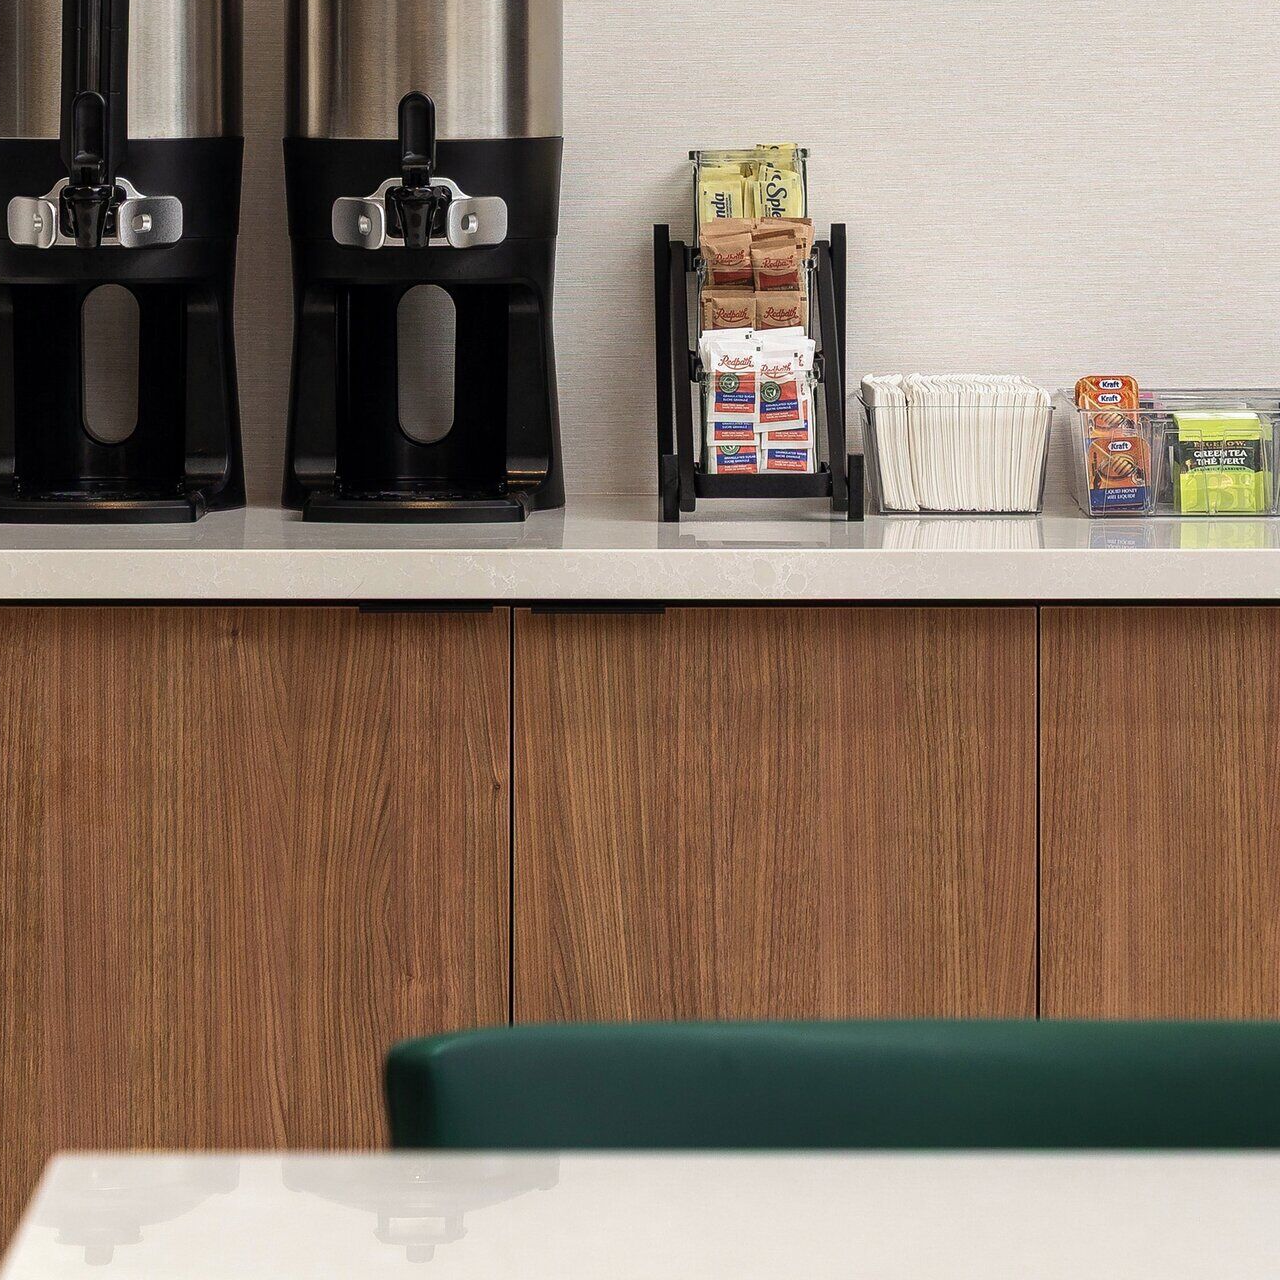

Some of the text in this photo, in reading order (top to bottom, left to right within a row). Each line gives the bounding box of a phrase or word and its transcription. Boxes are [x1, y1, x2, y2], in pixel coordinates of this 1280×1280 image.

[714, 308, 750, 323] Redpath
[764, 307, 799, 322] Redpath
[718, 355, 754, 370] Redpath
[1102, 380, 1120, 388] Kraft
[1110, 442, 1129, 450] Kraft
[1193, 449, 1248, 458] GREEN TEA
[1196, 456, 1246, 465] THÉ VERT
